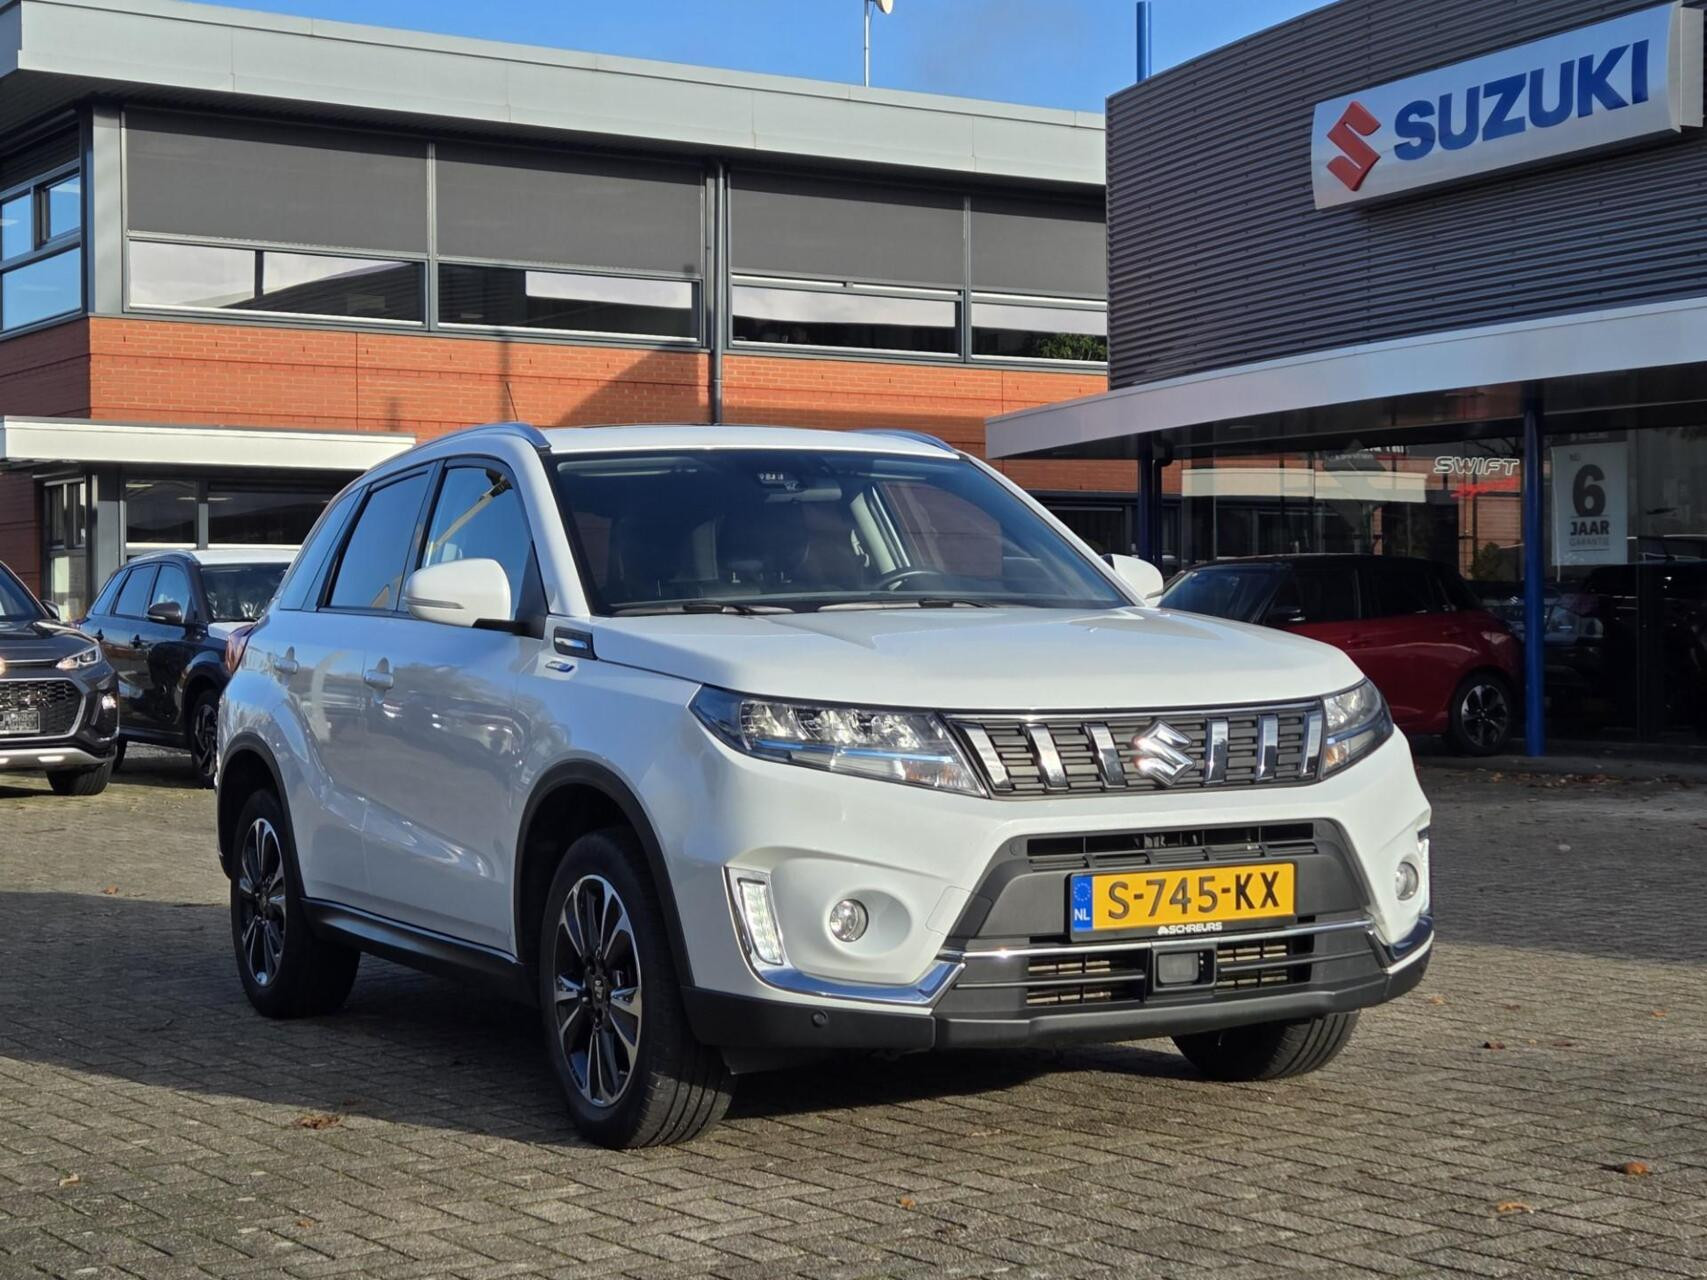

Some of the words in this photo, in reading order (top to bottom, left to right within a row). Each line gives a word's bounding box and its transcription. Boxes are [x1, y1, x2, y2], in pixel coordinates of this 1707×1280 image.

[1394, 39, 1649, 160] SUZUKI
[1433, 455, 1520, 476] SWIFT
[1573, 464, 1606, 517] 6
[1570, 520, 1610, 536] JAAR
[1108, 871, 1280, 920] S-745-KX
[1074, 908, 1090, 921] NL
[1168, 921, 1223, 935] SCHREURS
